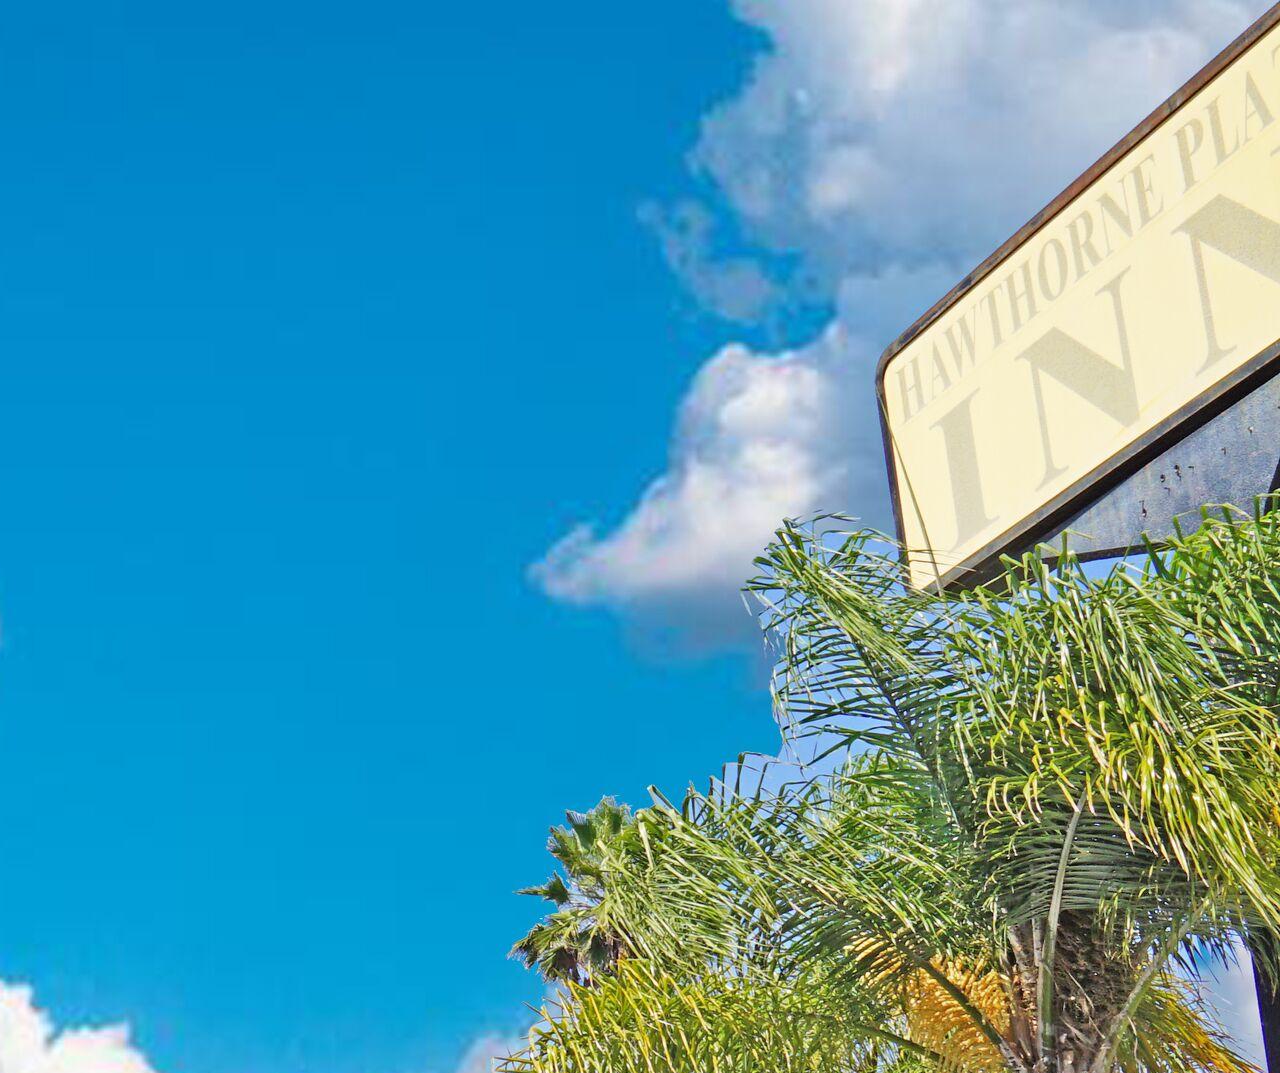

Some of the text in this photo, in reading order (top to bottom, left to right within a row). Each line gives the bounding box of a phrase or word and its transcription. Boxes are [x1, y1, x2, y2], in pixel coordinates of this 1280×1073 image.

[895, 44, 1280, 425] HAWTHORNE PLA
[929, 147, 1280, 552] INN
